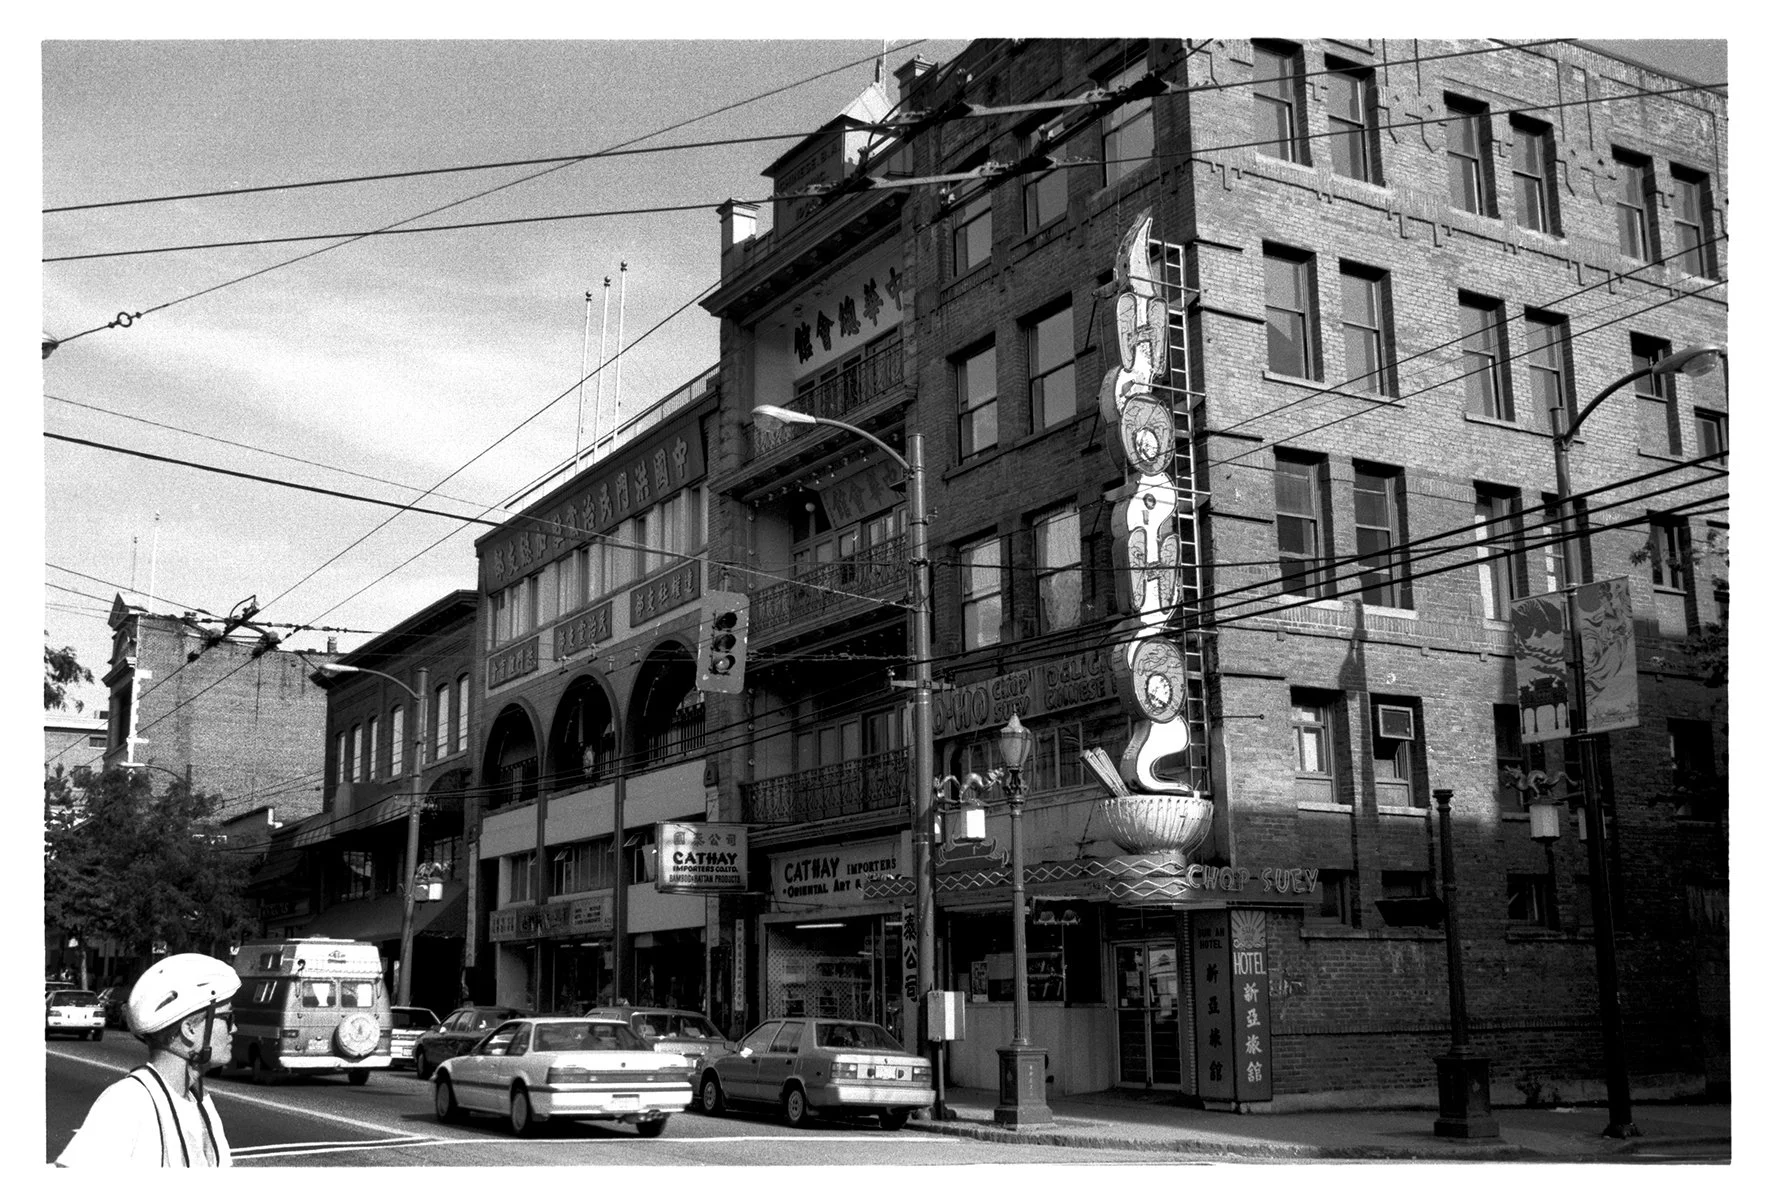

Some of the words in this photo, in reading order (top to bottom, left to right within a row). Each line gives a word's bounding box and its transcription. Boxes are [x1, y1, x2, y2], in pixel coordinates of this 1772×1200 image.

[932, 686, 990, 737] O-HO
[992, 673, 1028, 701] CHOP
[673, 851, 738, 865] CATHAY
[784, 857, 840, 883] CATHAY
[847, 858, 897, 875] IMPORTERS
[1186, 863, 1250, 892] CHOP
[1261, 866, 1320, 893] SUEY
[1200, 940, 1222, 949] HOTEL
[1233, 952, 1267, 975] HOTEL
[1206, 963, 1223, 1082] 新亞旅館
[1243, 981, 1263, 1083] 新亞旅館
